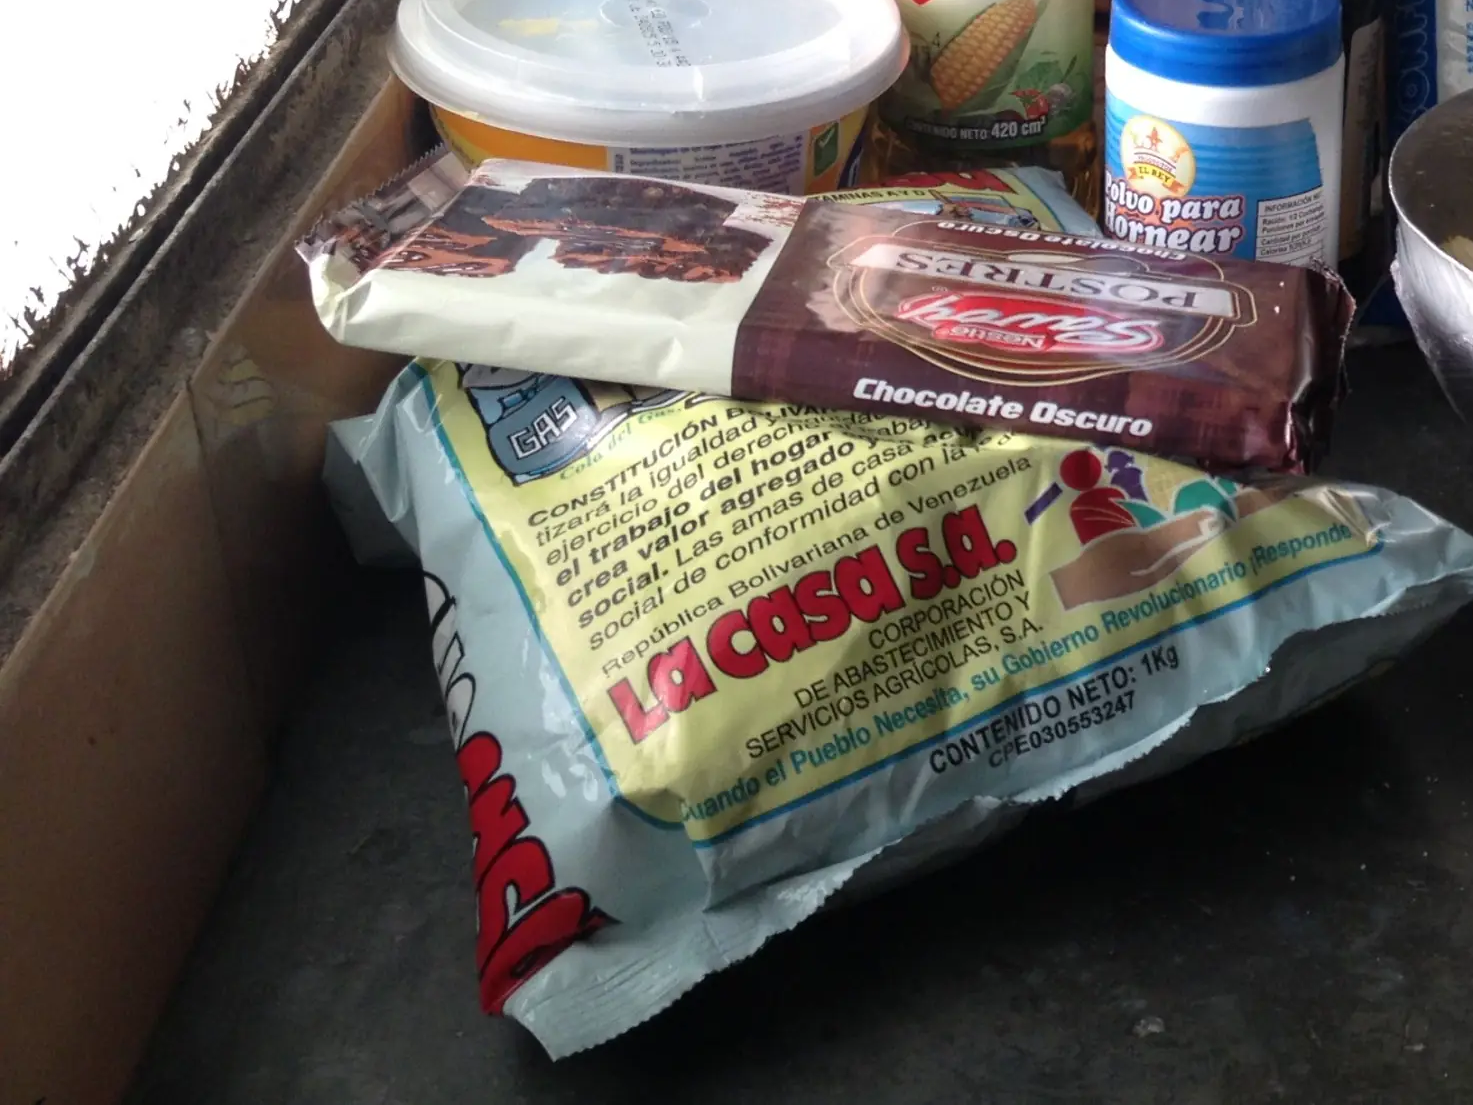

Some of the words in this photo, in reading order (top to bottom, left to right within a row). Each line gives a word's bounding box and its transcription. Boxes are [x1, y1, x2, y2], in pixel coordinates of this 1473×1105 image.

[990, 120, 1018, 139] 420
[935, 220, 1053, 244] Oscuro
[1054, 234, 1189, 262] Chocolate
[1105, 171, 1155, 214] Polvo
[1161, 197, 1242, 224] para
[1105, 201, 1243, 254] Hornear
[895, 251, 1202, 310] POSTRES
[508, 396, 578, 460] GAS
[853, 377, 1024, 421] Chocolate
[1029, 401, 1153, 437] Oscuro
[527, 414, 719, 528] CONSTITUCIÓN
[536, 501, 611, 548] tizará
[619, 485, 644, 506] la
[649, 415, 758, 491] igualdad
[546, 497, 658, 567] ejercicio
[667, 463, 706, 500] del
[555, 560, 581, 587] el
[588, 501, 691, 566] trabajo
[699, 467, 743, 503] del
[750, 430, 834, 479] hogar
[567, 558, 629, 608] crea
[637, 509, 710, 561] valor
[720, 440, 855, 515] agregado
[578, 562, 670, 630] social.
[674, 529, 725, 568] Las
[731, 488, 805, 537] amas
[811, 468, 845, 496] de
[851, 443, 915, 477] casa
[589, 586, 665, 652] social
[672, 566, 707, 595] de
[714, 477, 881, 573] conformidad
[887, 456, 936, 489] con
[942, 440, 968, 466] la
[602, 595, 725, 676] República
[727, 526, 871, 599] Bolivariana
[873, 506, 906, 532] de
[907, 453, 1032, 516] Venezuela
[606, 634, 718, 745] La
[705, 544, 905, 680] casa
[794, 678, 826, 709] DE
[831, 606, 1015, 691] ABASTECIMIENTO
[1010, 591, 1031, 613] Y
[868, 568, 1026, 650] CORPORACIÓN
[680, 775, 761, 823] Cuando
[765, 761, 788, 787] el
[789, 724, 873, 775] Pueblo
[870, 681, 972, 738] Necesita,
[970, 665, 1001, 694] su
[1000, 622, 1100, 677] Gobierno
[1099, 556, 1249, 636] Revolucionario
[745, 693, 871, 759] SERVICIOS
[872, 639, 1001, 704] AGRÍCOLAS,
[1000, 615, 1045, 646] S.A.
[929, 688, 1063, 777] CONTENIDO
[1066, 663, 1138, 714] NETO:
[1140, 642, 1182, 688] 1Kg
[987, 690, 1137, 770] CPE030553247
